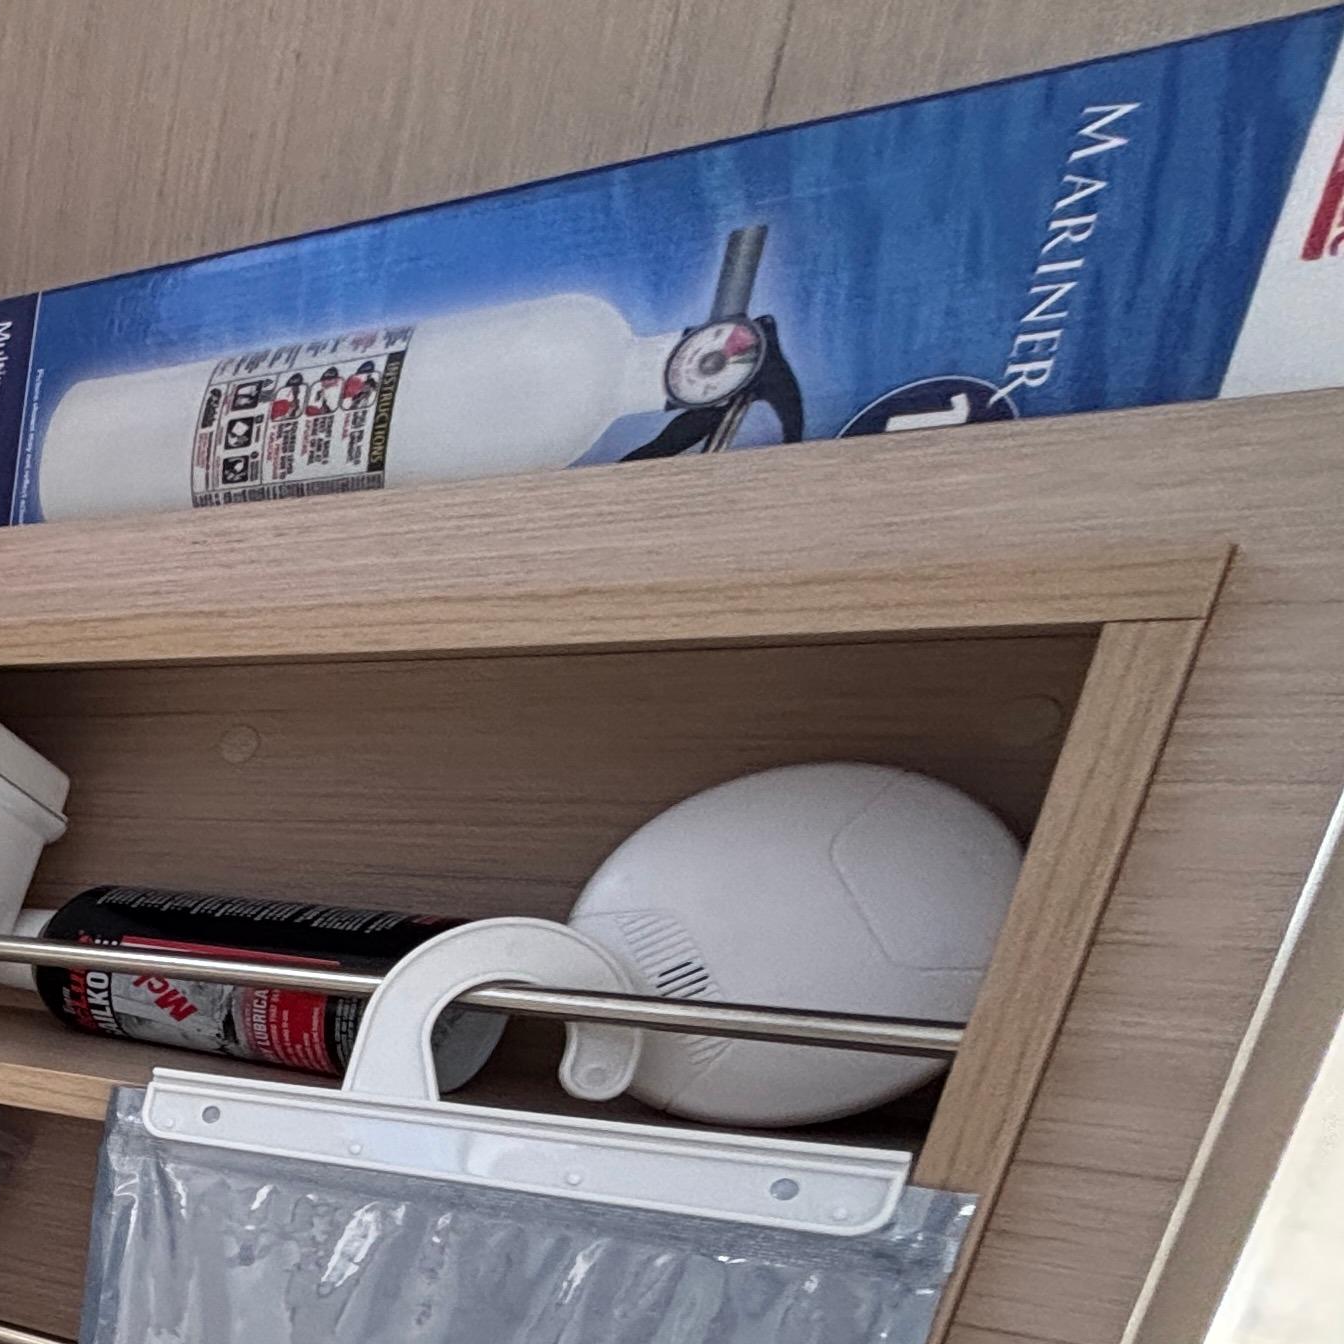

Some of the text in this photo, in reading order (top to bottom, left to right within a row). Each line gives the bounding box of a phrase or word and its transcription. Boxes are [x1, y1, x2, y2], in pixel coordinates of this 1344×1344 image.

[988, 102, 1143, 408] MARINER
[369, 361, 402, 464] INSTRUCTIONS
[253, 988, 270, 1047] LUBRICA
